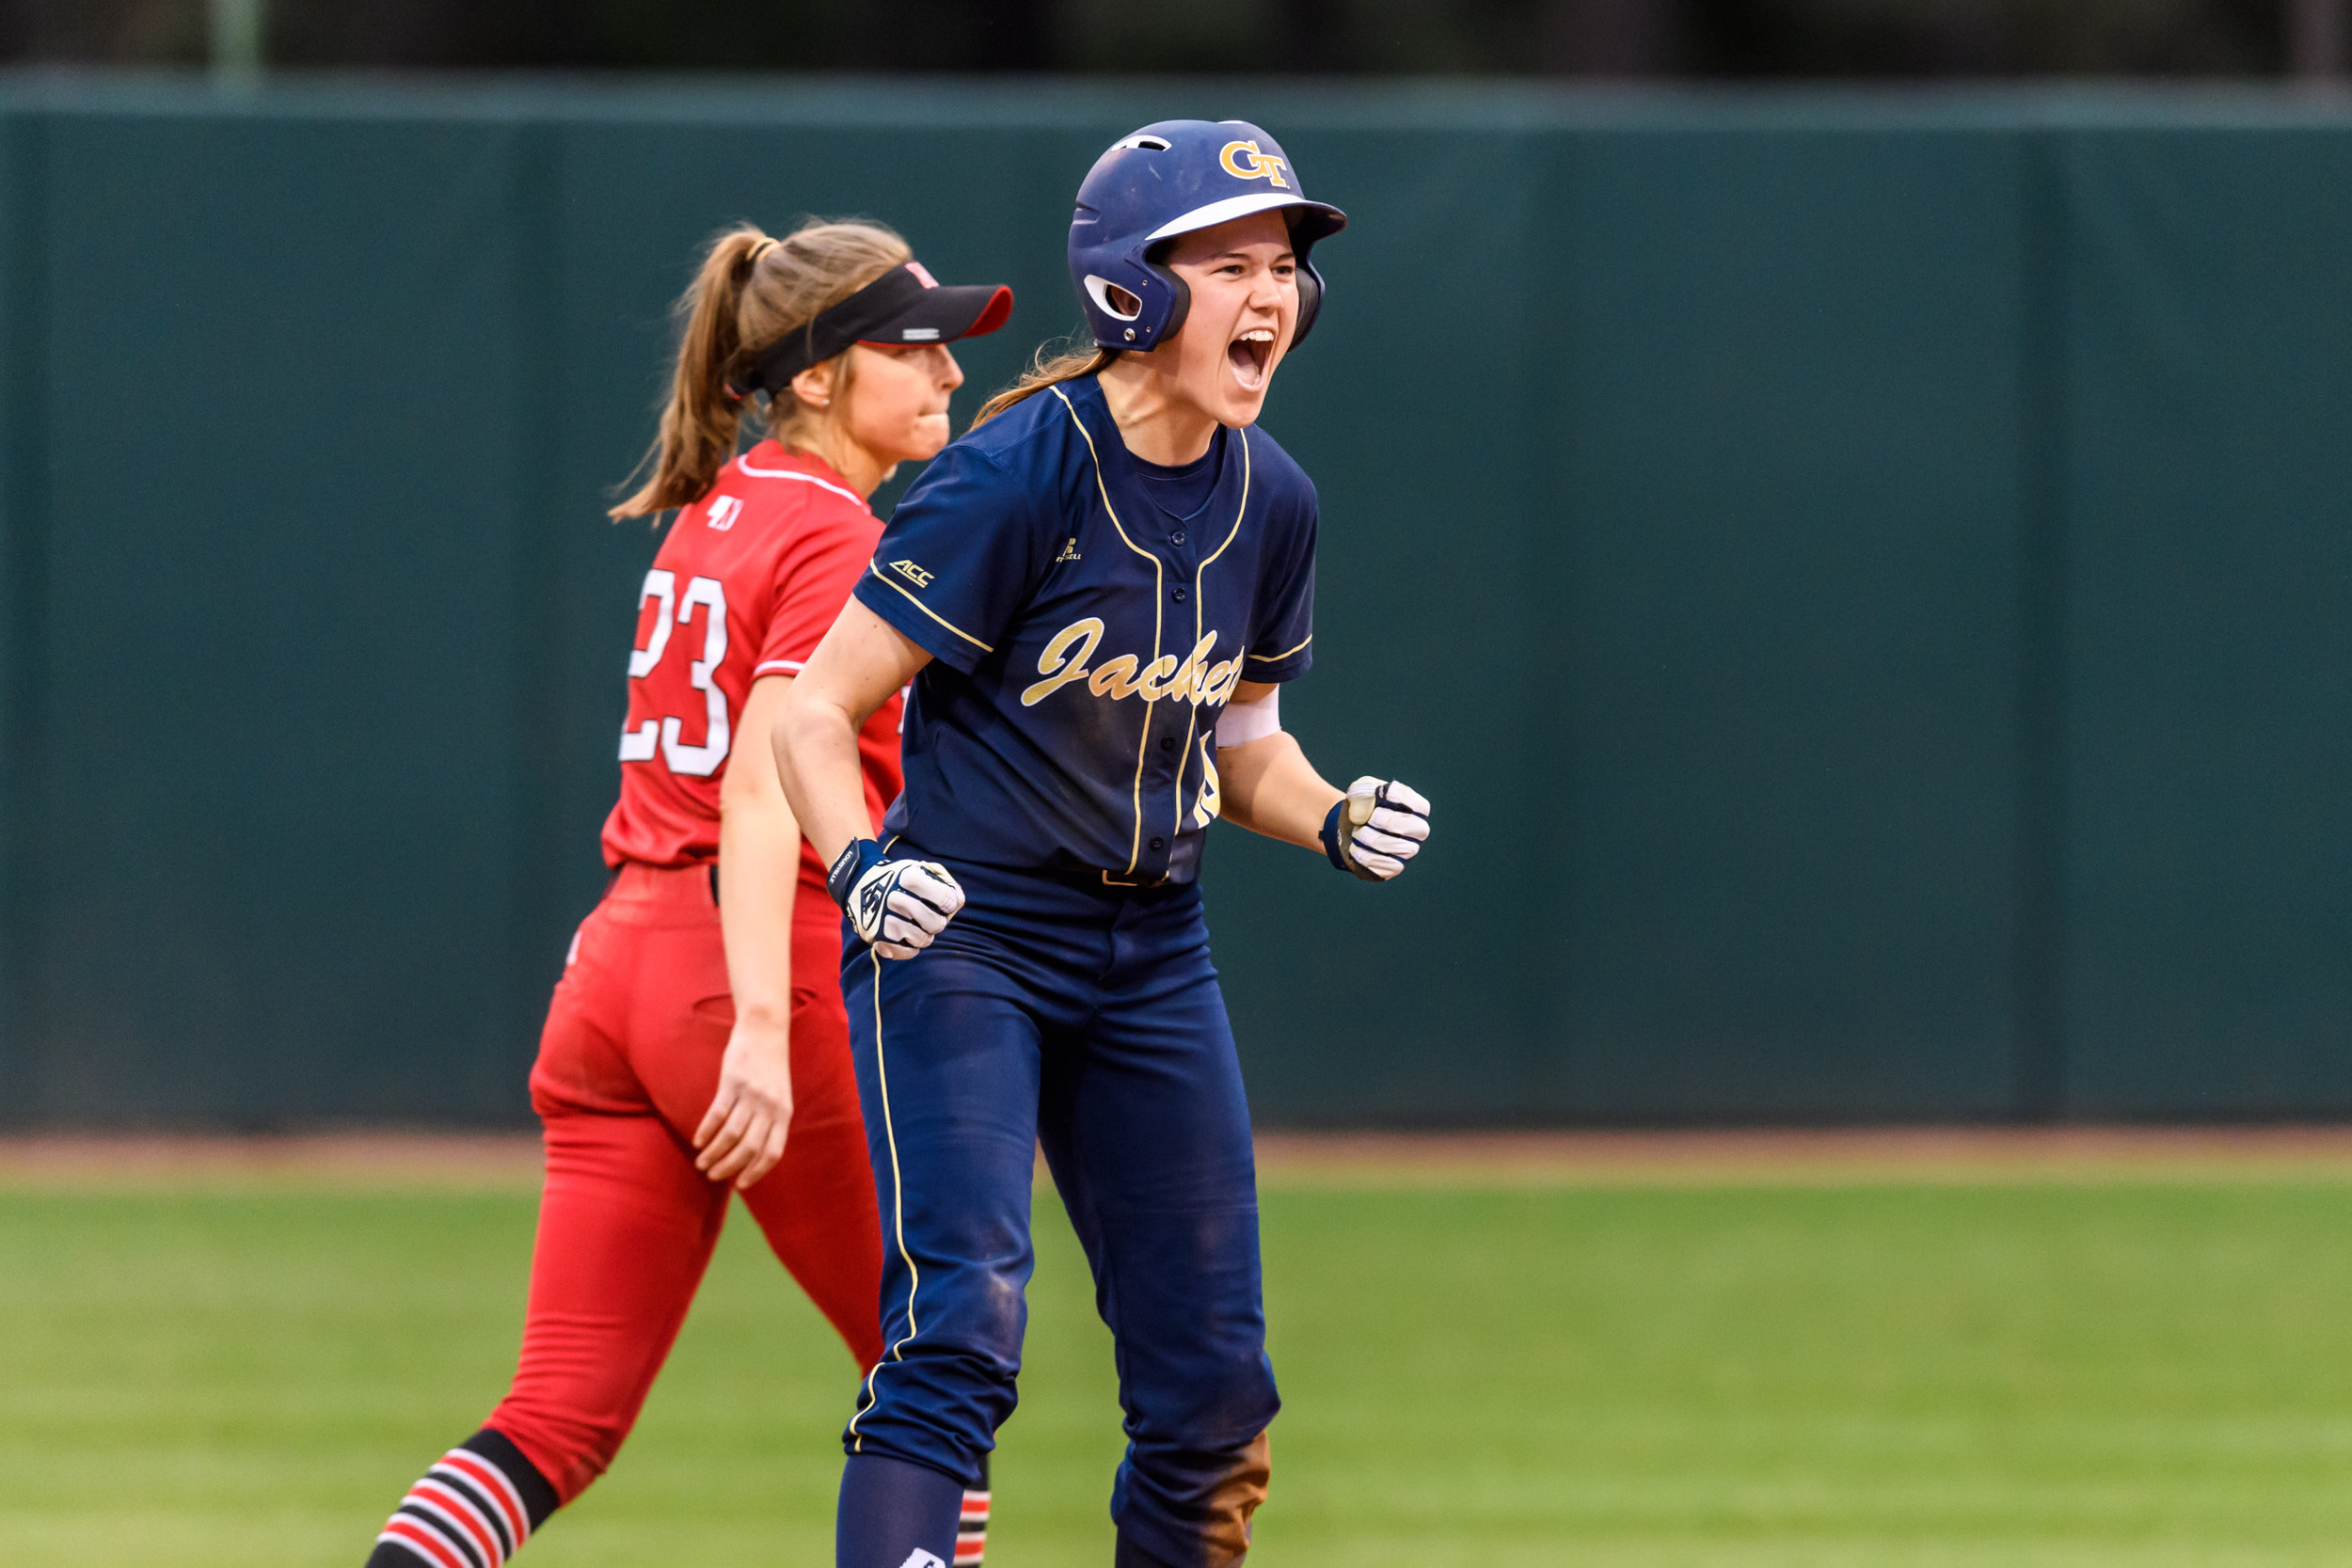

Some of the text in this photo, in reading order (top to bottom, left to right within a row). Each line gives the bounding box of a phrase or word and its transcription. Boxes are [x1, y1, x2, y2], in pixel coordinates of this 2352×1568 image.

[1219, 140, 1287, 187] GT
[889, 559, 935, 589] ACC
[618, 568, 731, 777] 23
